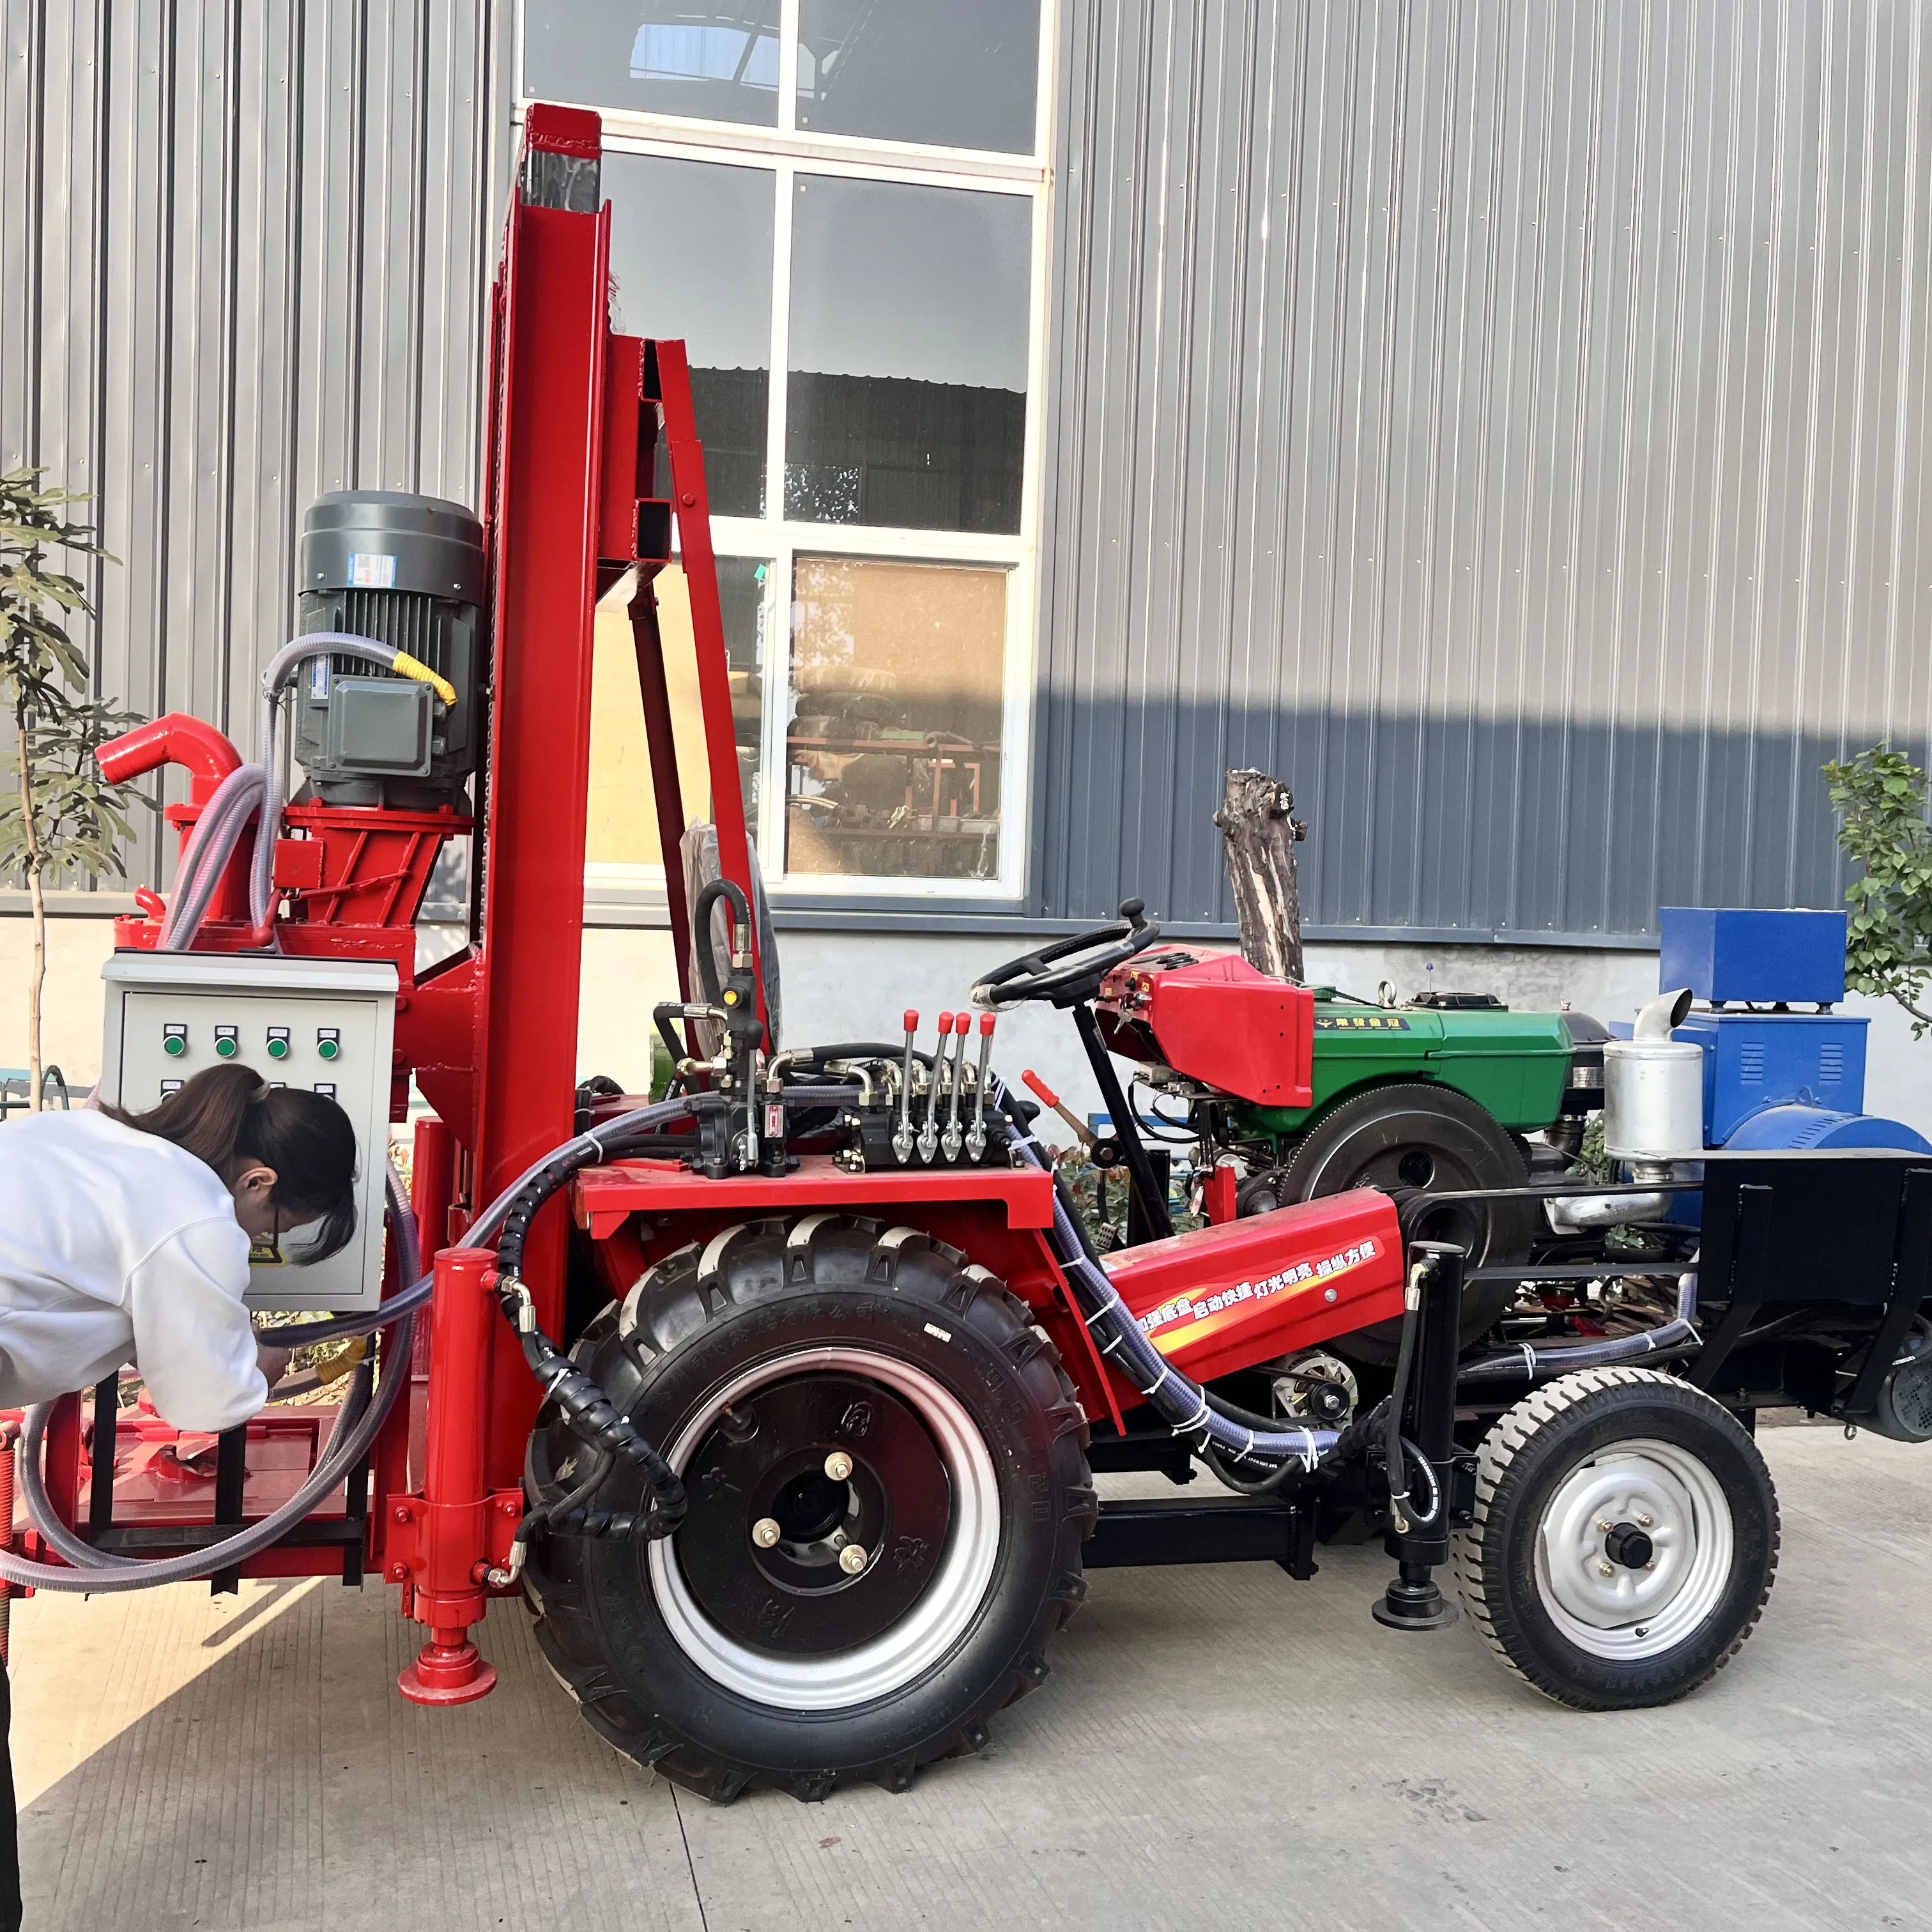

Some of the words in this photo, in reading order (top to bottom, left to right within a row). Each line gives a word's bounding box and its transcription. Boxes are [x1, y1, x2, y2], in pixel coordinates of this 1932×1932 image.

[1192, 1281, 1254, 1320] 启动快捷
[1254, 1262, 1314, 1300] 灯光明亮
[1315, 1240, 1376, 1278] 操纵方便
